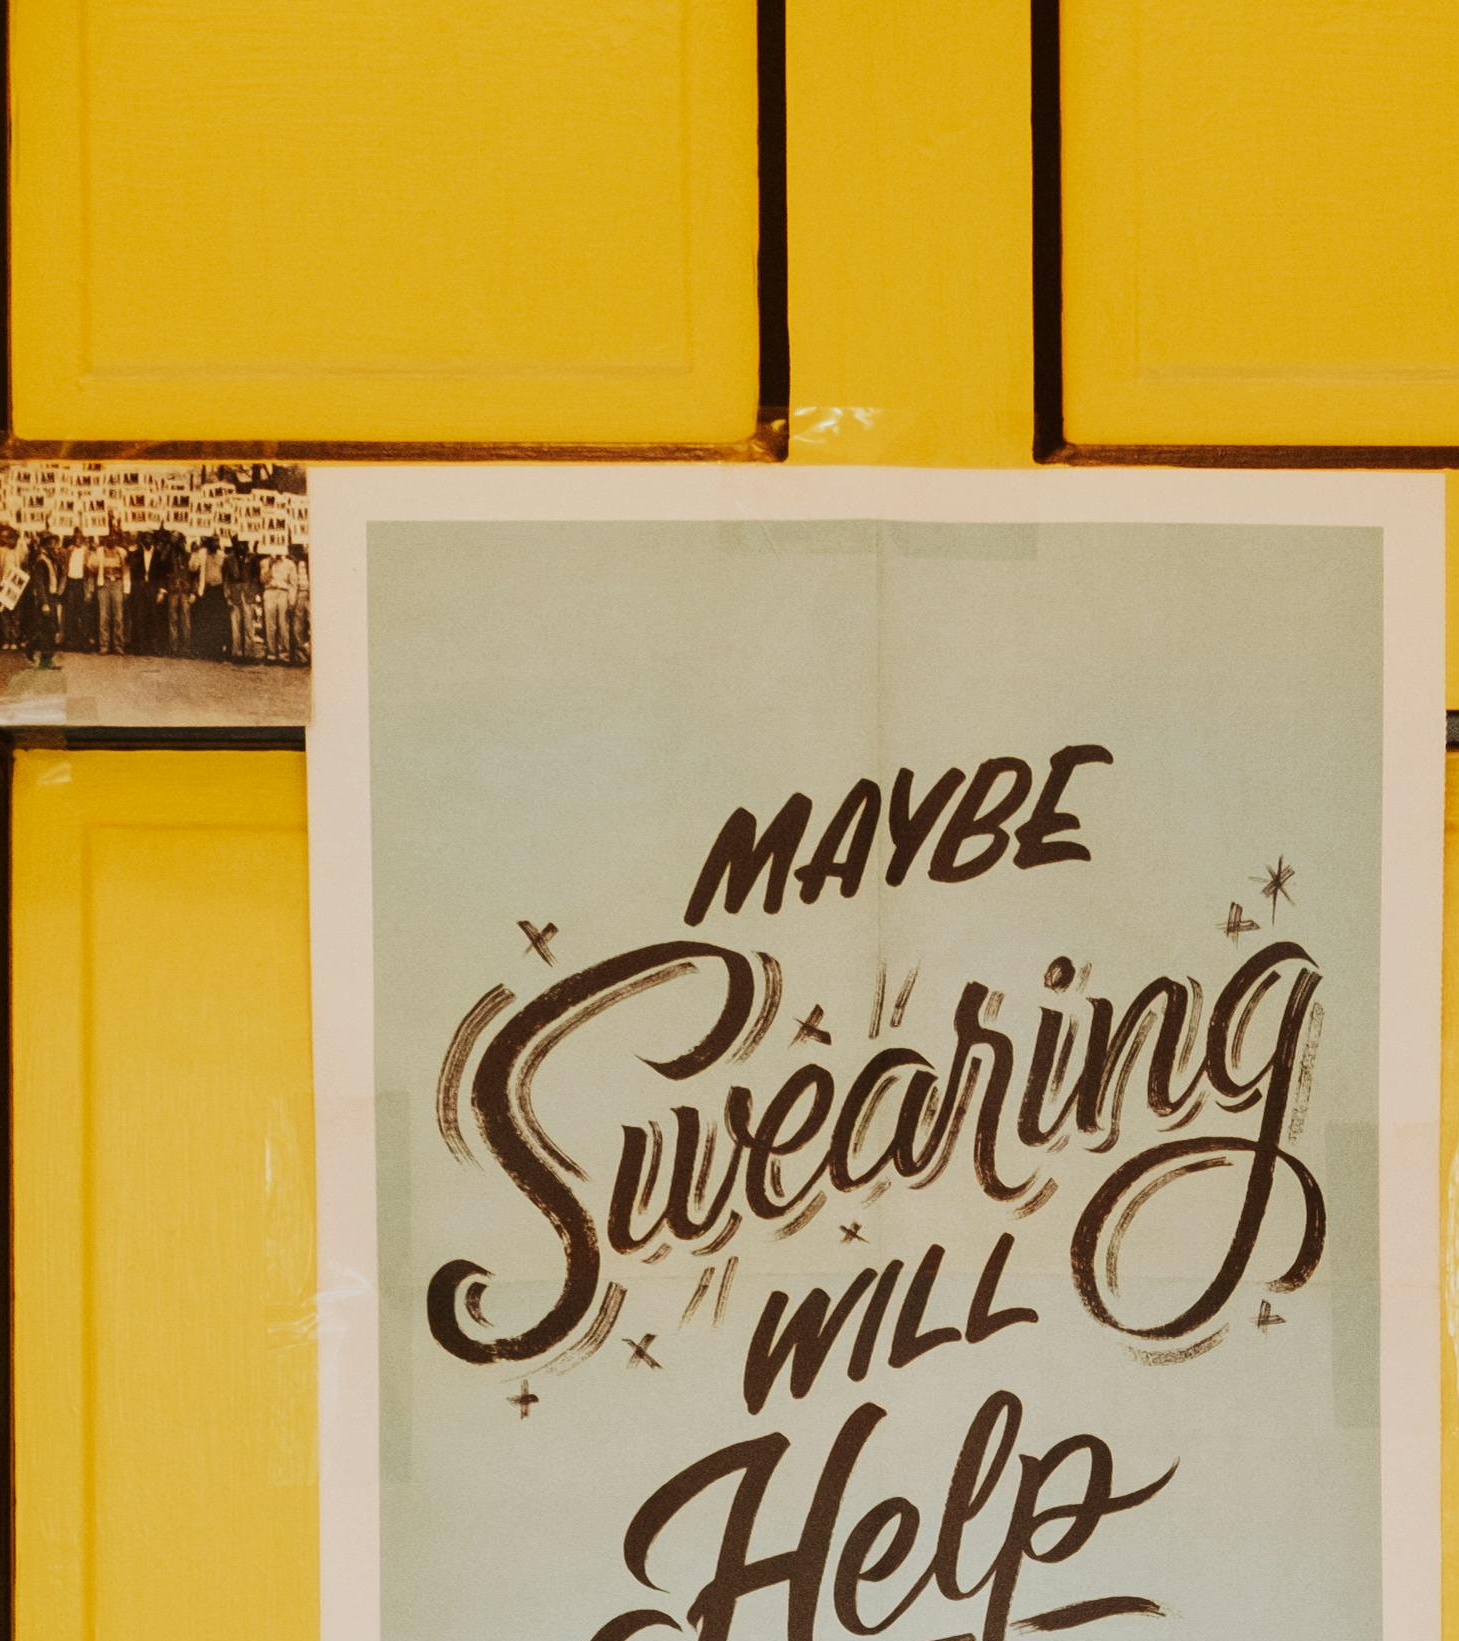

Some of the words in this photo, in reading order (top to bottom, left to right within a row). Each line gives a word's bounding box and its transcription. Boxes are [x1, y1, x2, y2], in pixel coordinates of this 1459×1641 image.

[684, 743, 1114, 926] MAYBE
[427, 936, 1327, 1366] Swearing
[744, 1232, 1039, 1415] WILL
